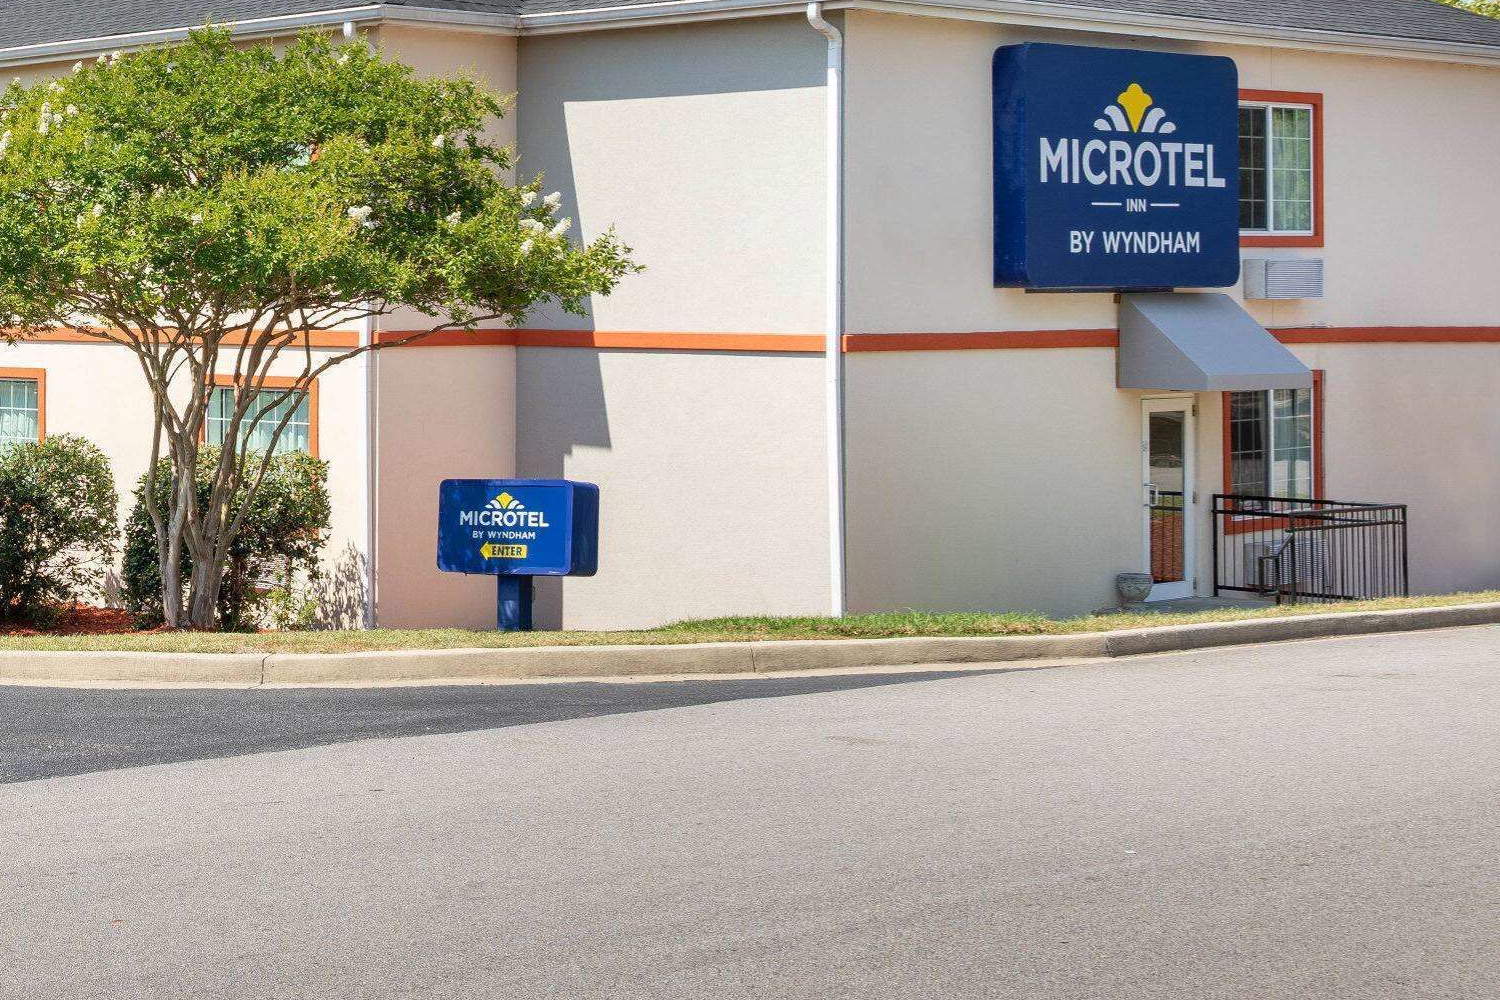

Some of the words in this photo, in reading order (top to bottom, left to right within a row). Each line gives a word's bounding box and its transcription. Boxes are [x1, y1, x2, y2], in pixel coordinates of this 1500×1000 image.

[1039, 137, 1226, 188] MICROTEL
[1126, 198, 1147, 213] INN
[1069, 230, 1095, 254] BY
[1102, 230, 1201, 254] WYNDHAM
[459, 510, 550, 528] MICROTEL
[472, 530, 485, 539] BY
[487, 530, 536, 540] WYNDHAM
[491, 545, 523, 556] ENTER
